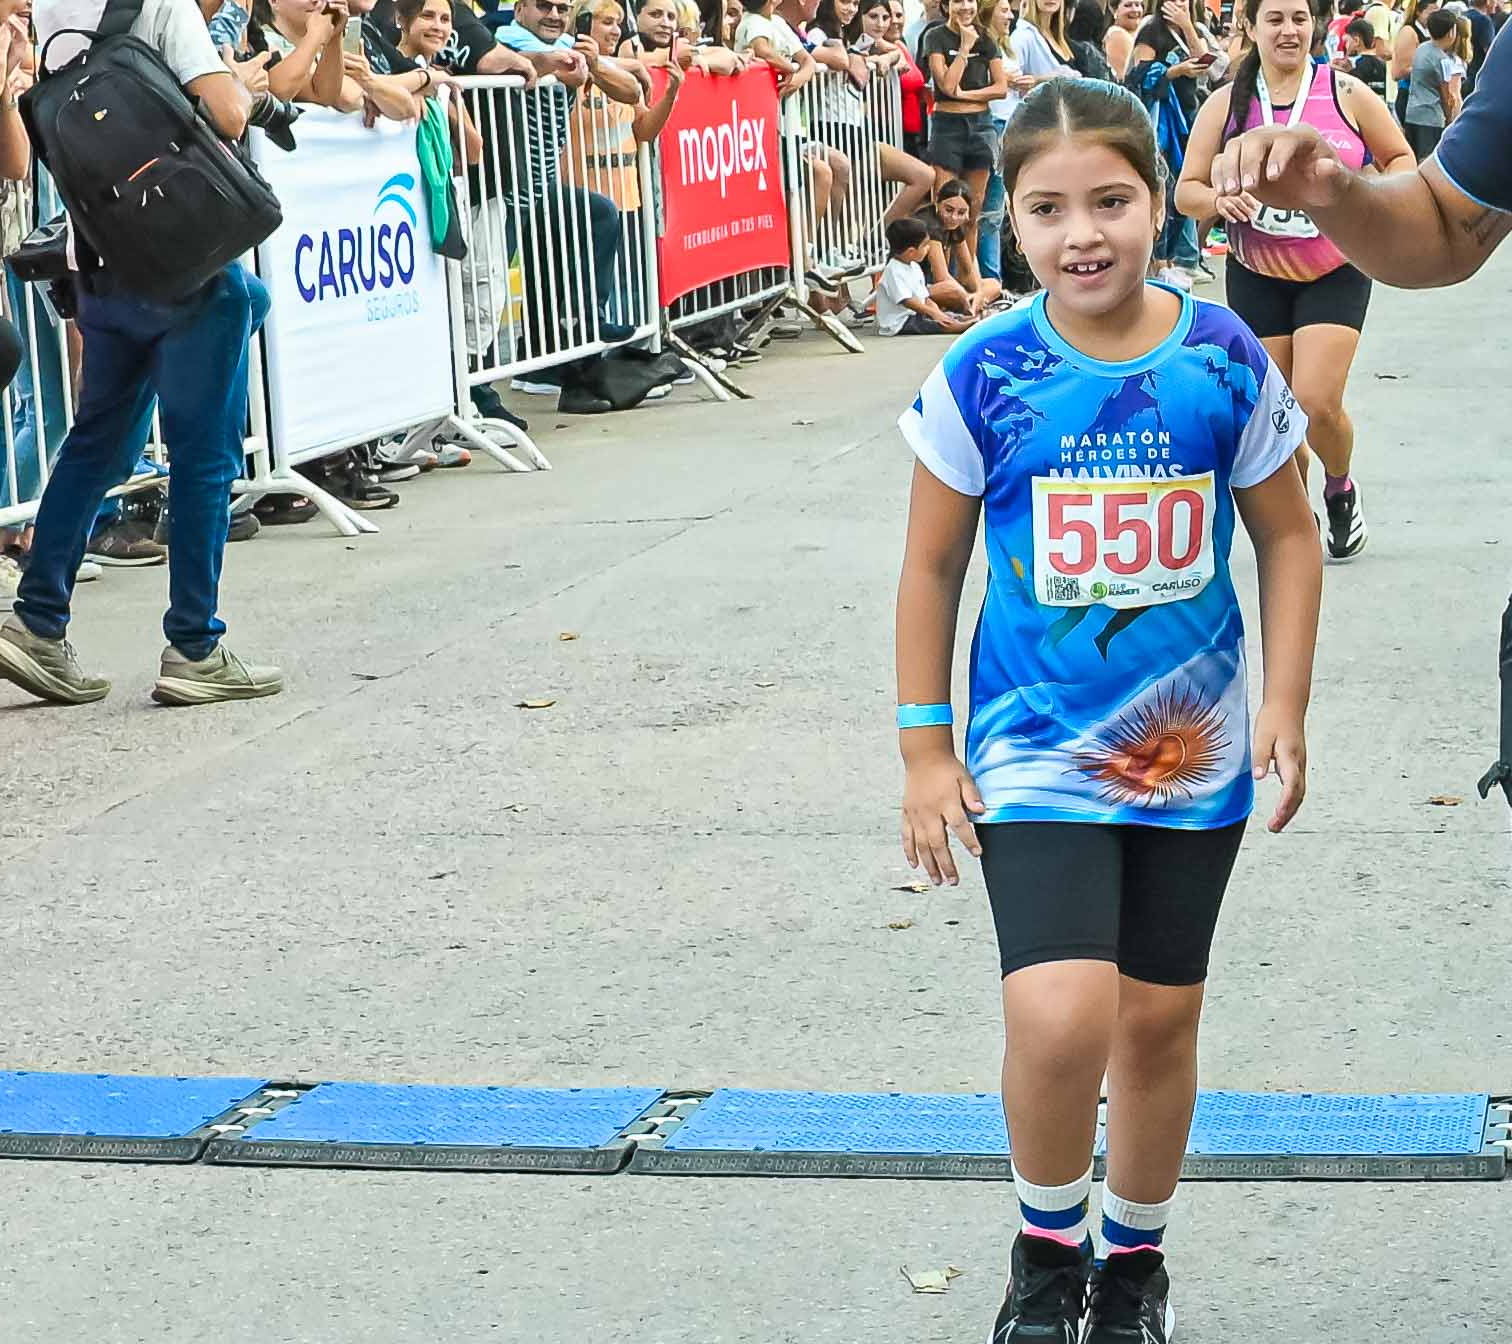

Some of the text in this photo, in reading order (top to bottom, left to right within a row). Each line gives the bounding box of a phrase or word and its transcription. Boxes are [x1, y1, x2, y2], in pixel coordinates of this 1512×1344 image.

[678, 99, 768, 199] moplex
[294, 221, 415, 304] CARUSO
[1060, 429, 1171, 449] MARATÓN
[1060, 447, 1171, 463] HÉROES DE
[1047, 488, 1205, 576] 550
[1151, 577, 1202, 593] CARUSO
